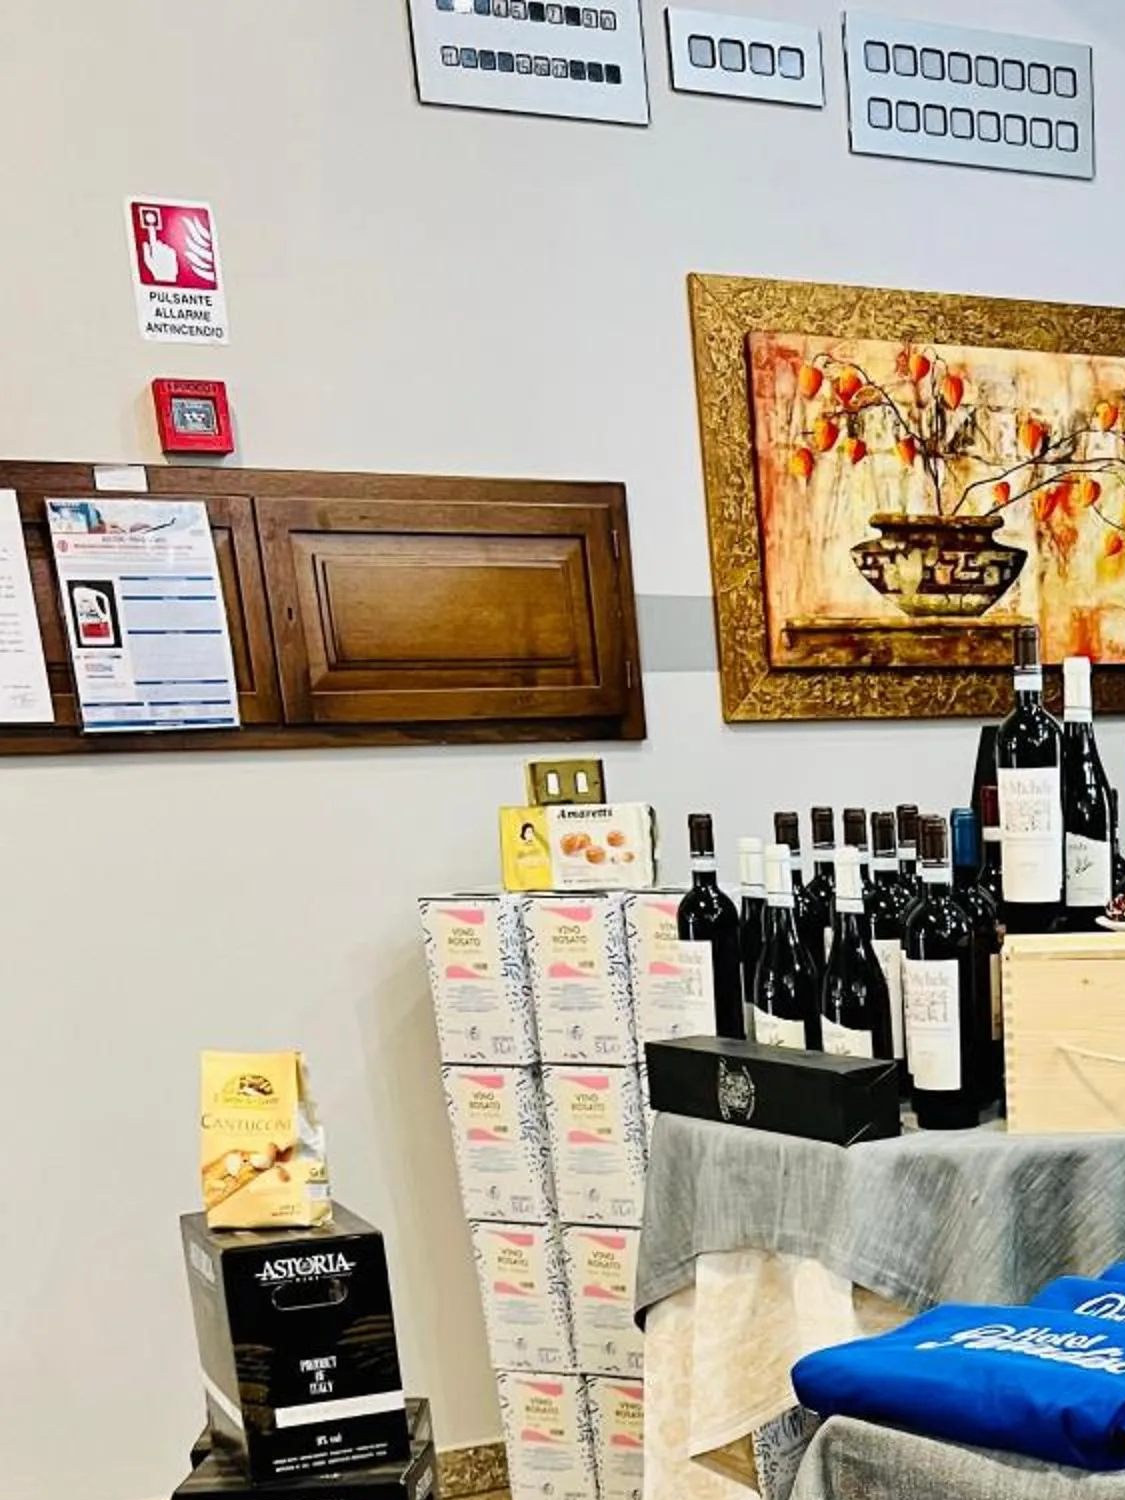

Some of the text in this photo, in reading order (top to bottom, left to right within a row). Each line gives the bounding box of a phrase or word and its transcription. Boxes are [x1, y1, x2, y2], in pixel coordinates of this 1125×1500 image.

[149, 291, 213, 307] PULSANTE
[155, 308, 211, 322] ALLARME
[146, 322, 224, 338] ANTINCENDIO
[557, 808, 613, 819] Amaretti
[659, 923, 677, 932] VIN
[655, 932, 678, 941] ROSA
[200, 1113, 292, 1132] CANTUCCINI
[256, 1252, 356, 1281] ASTORIA
[1010, 1327, 1109, 1350] Hotel
